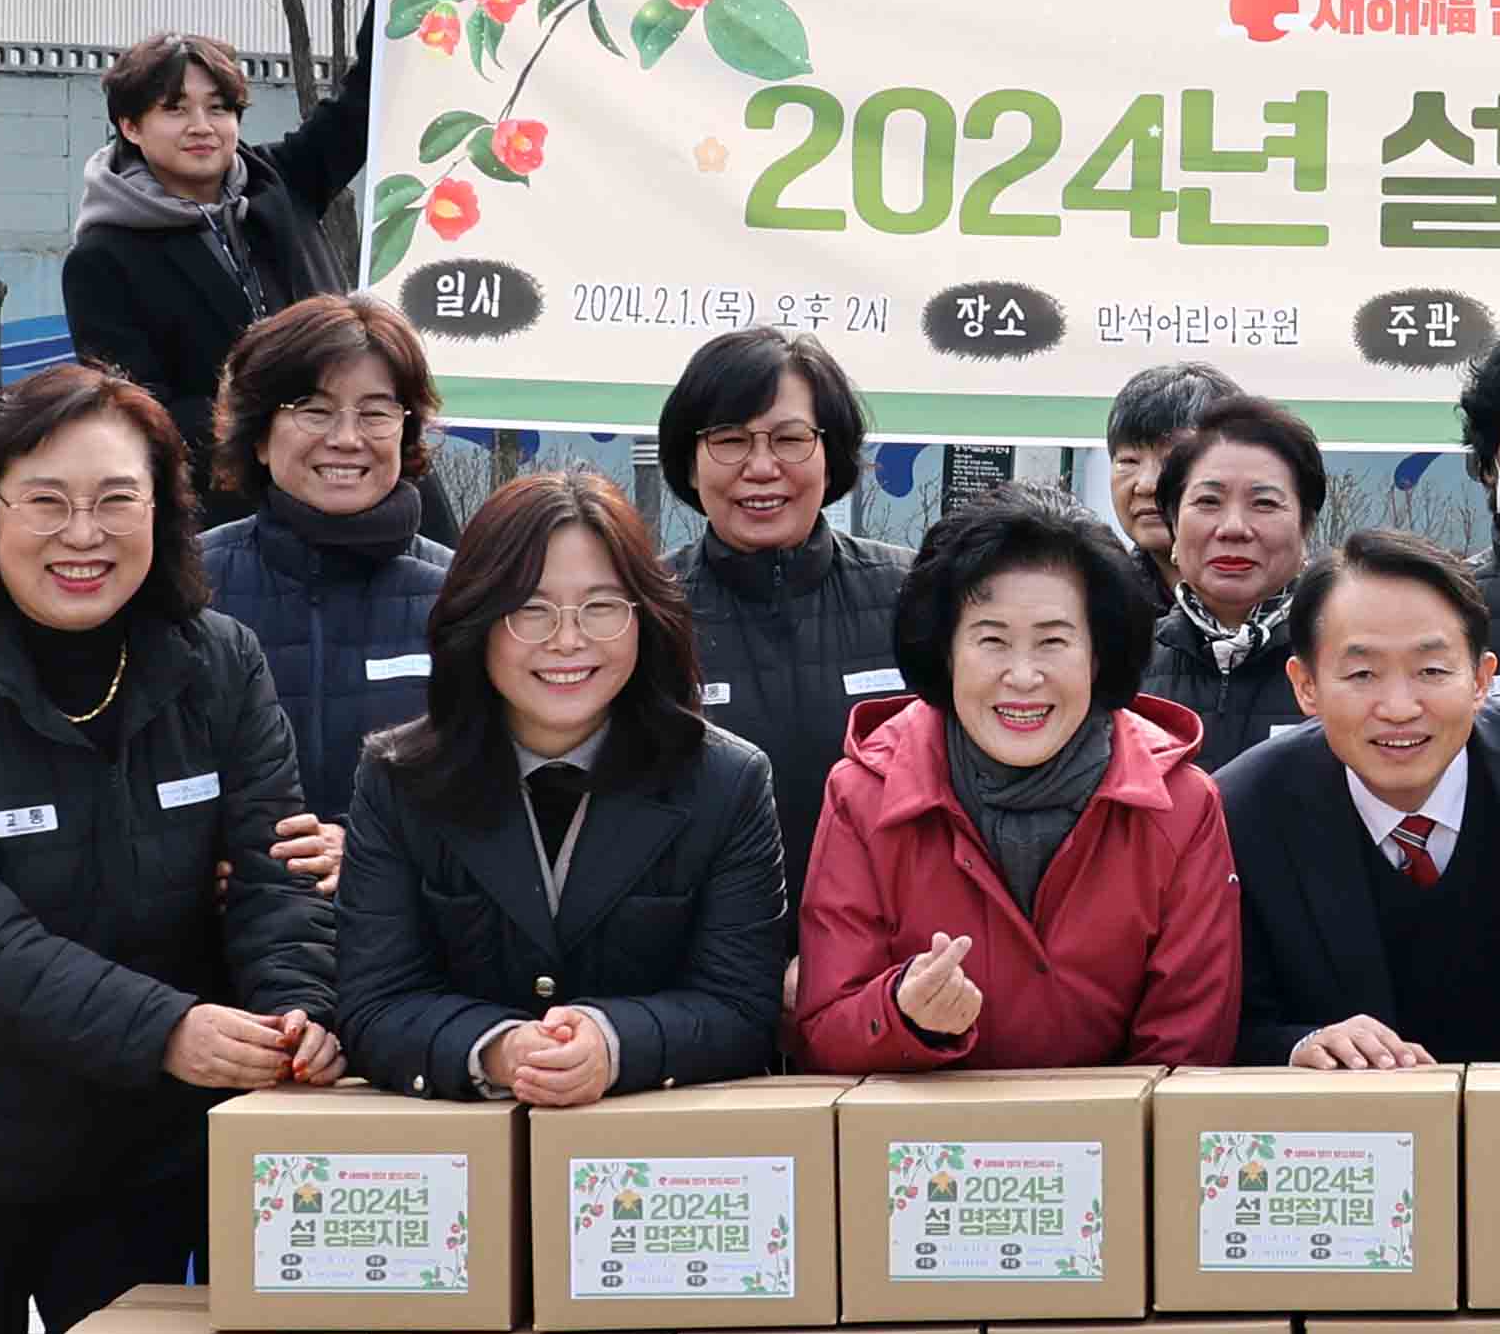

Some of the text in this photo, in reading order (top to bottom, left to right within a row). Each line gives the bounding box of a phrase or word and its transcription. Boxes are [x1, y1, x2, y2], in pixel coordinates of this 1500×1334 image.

[744, 84, 1329, 247] 2024년
[434, 270, 501, 319] 일시
[572, 283, 756, 328] 2024.2.1.(목)
[771, 292, 832, 331] 오후
[846, 296, 890, 333] 2시
[955, 294, 1027, 338] 장소
[1098, 303, 1300, 346] 만석어린이공원
[1386, 301, 1460, 348] 주관
[331, 1187, 430, 1215] 2024년
[965, 1175, 1064, 1204] 2024년
[291, 1218, 430, 1247] 설 명절지원
[925, 1207, 1065, 1236] 설 명절지원
